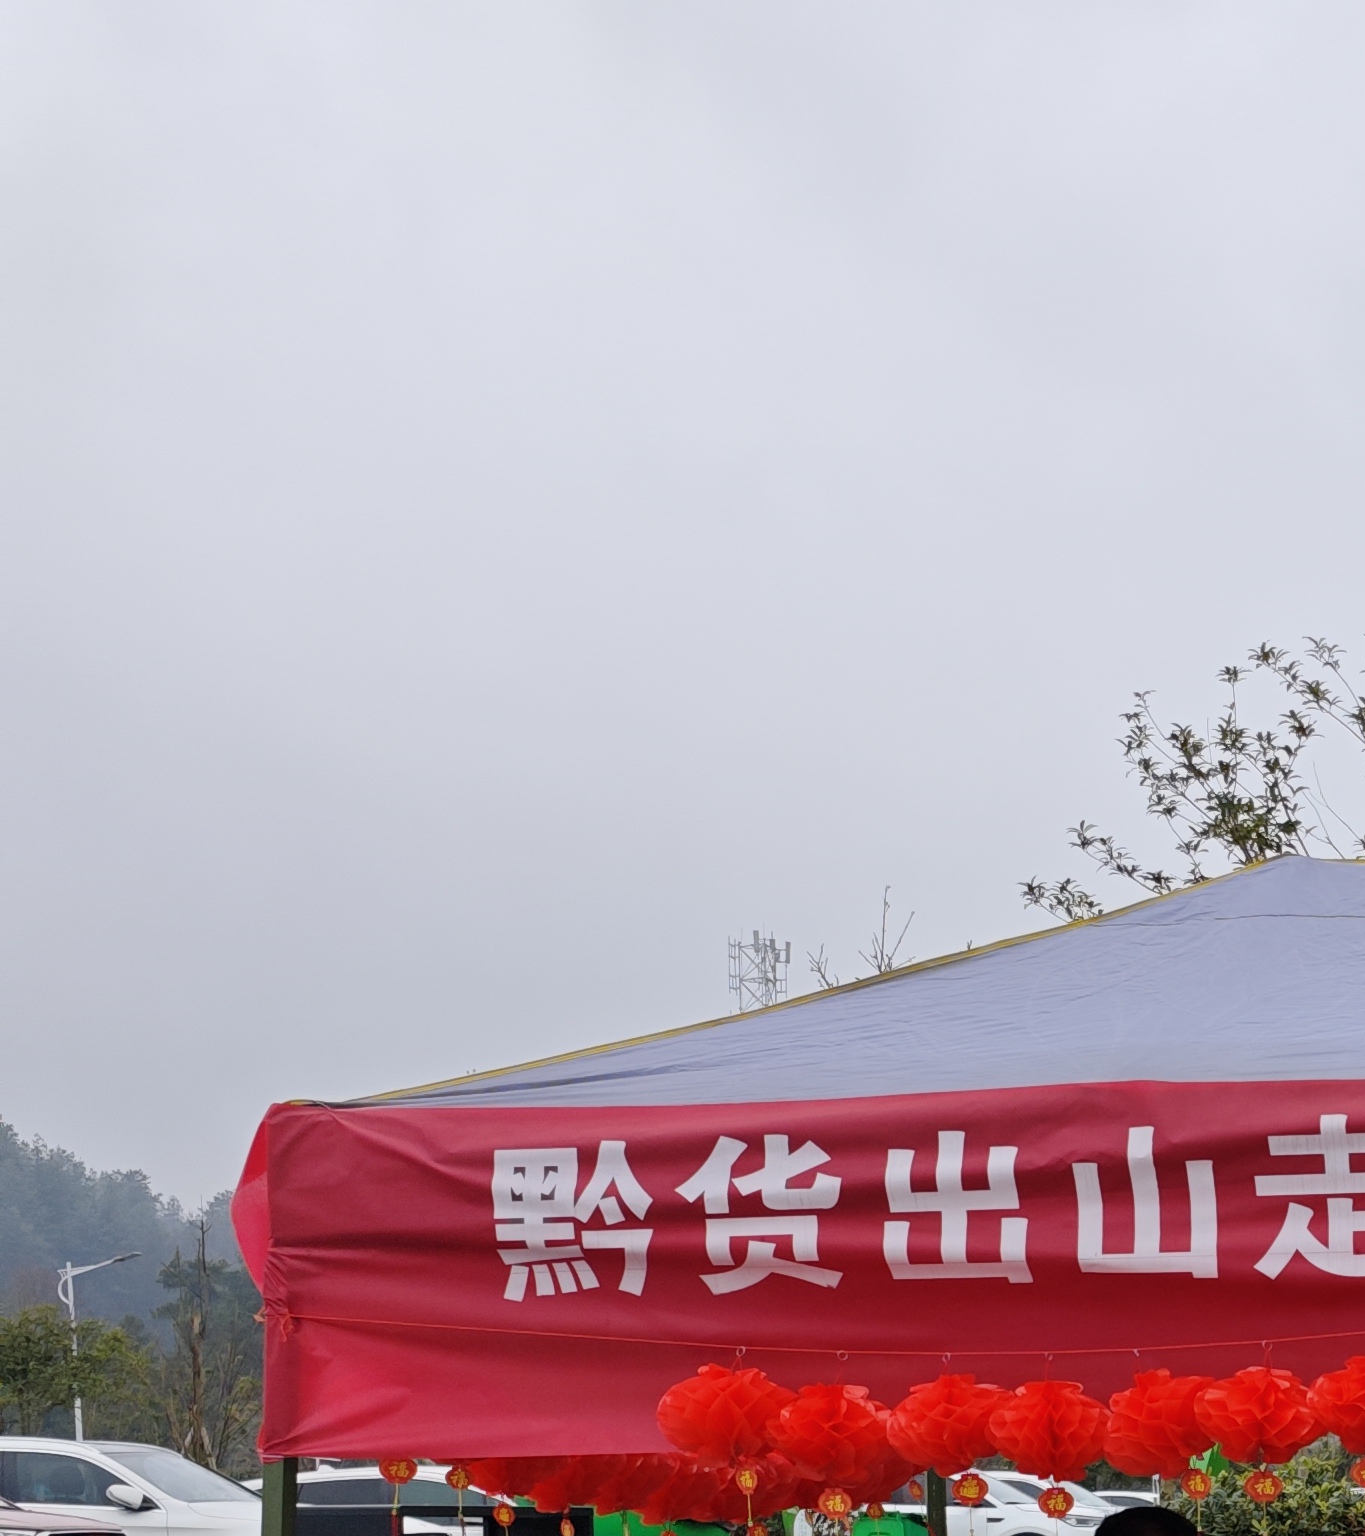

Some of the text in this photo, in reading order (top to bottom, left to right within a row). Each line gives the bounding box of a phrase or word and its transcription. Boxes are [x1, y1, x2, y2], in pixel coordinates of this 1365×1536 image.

[1188, 1476, 1204, 1492] 福
[1254, 1478, 1274, 1495] 福
[827, 1495, 845, 1512] 福
[1047, 1494, 1067, 1512] 福
